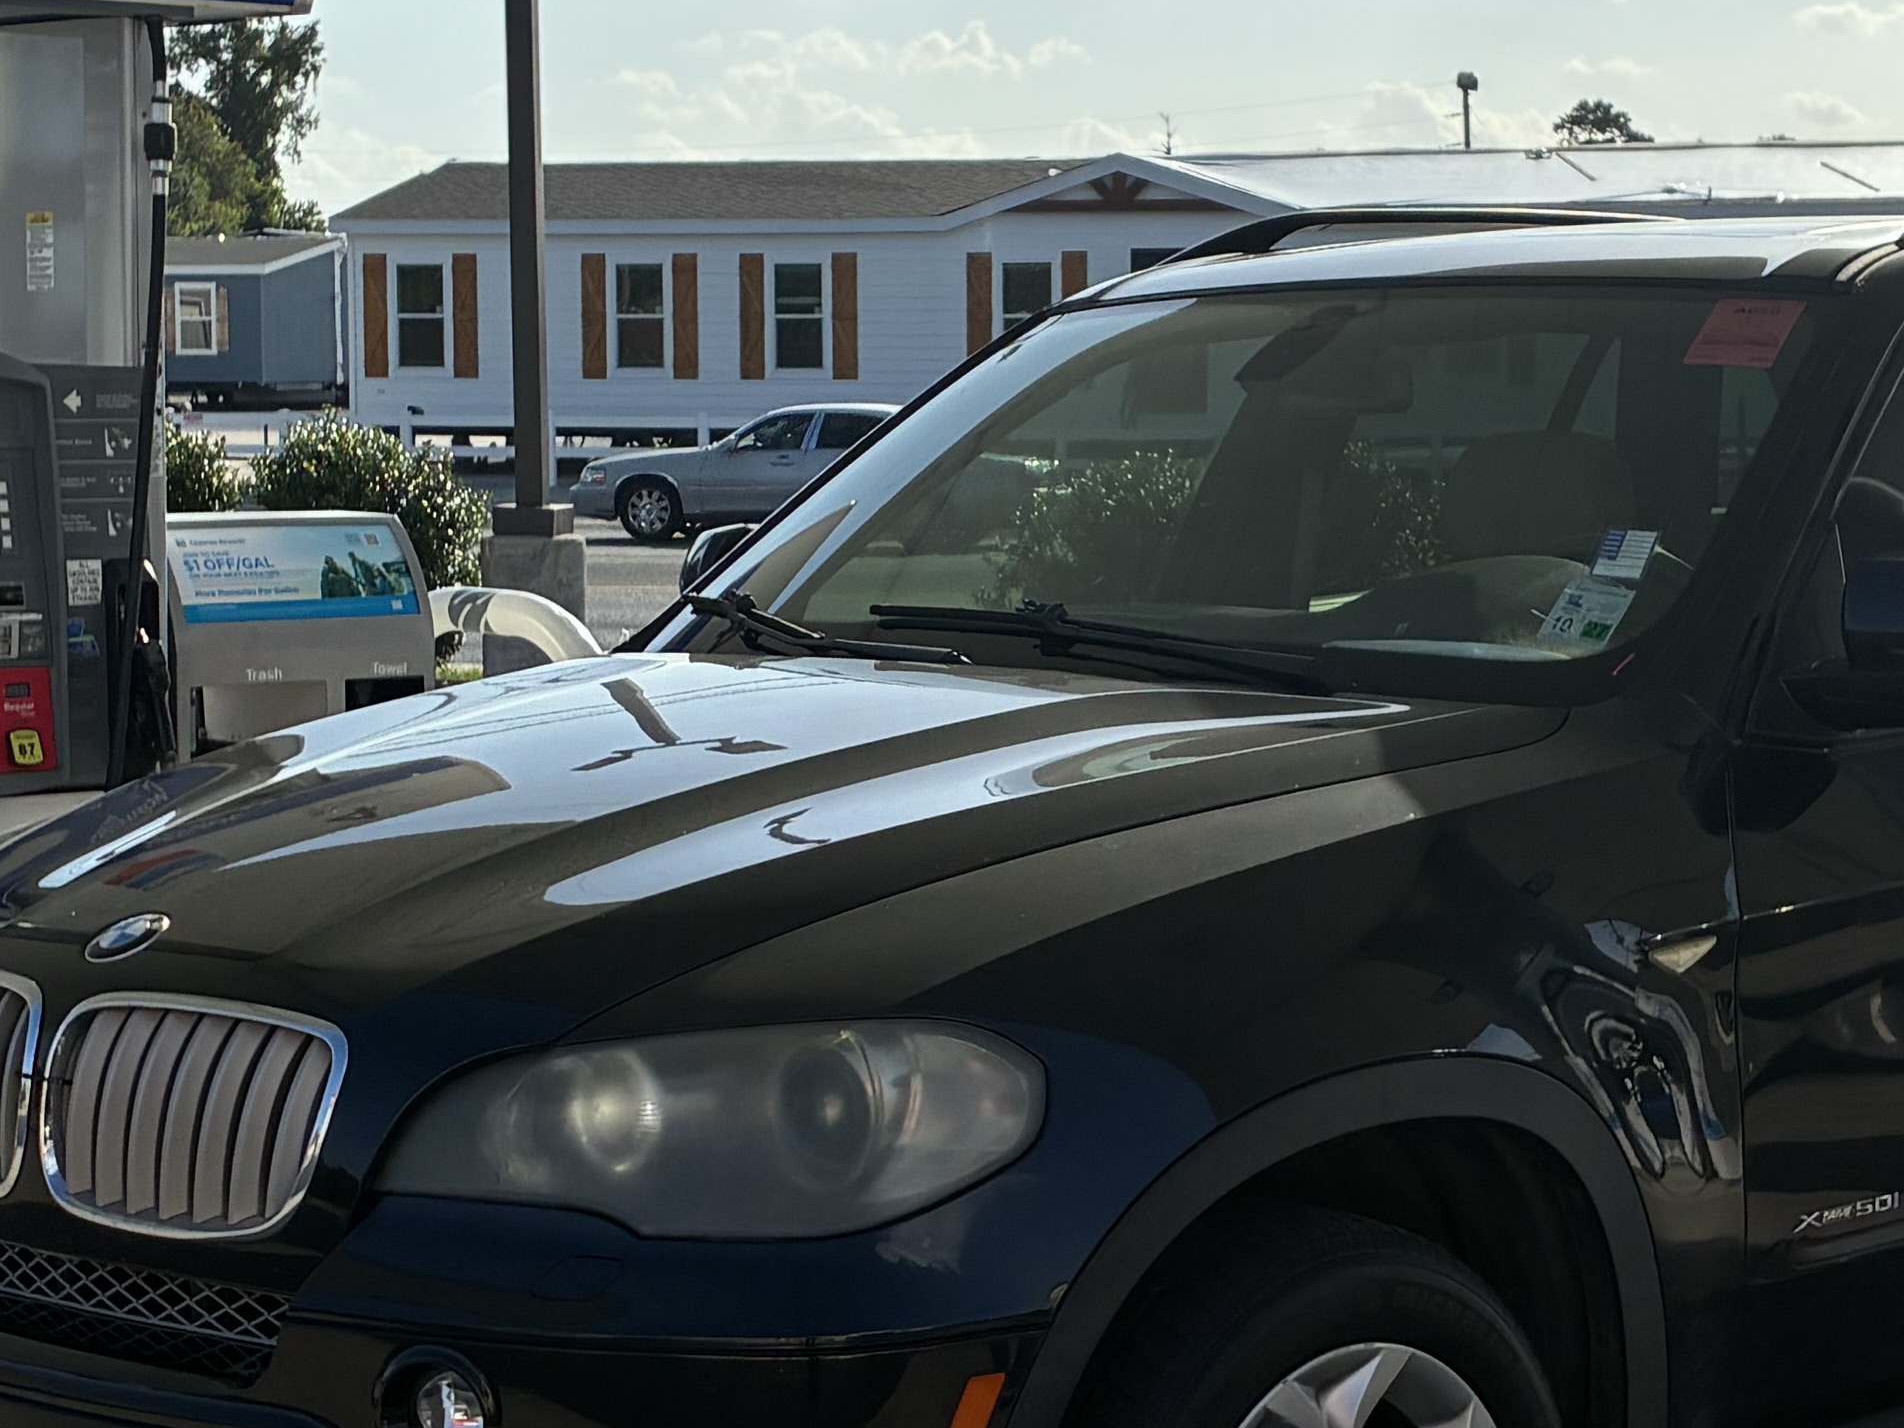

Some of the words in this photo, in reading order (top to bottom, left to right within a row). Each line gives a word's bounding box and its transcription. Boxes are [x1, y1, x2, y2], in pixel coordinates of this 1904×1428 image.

[184, 559, 200, 571] $1
[1552, 615, 1574, 633] 10
[246, 667, 282, 681] Trash
[374, 661, 407, 675] Towel
